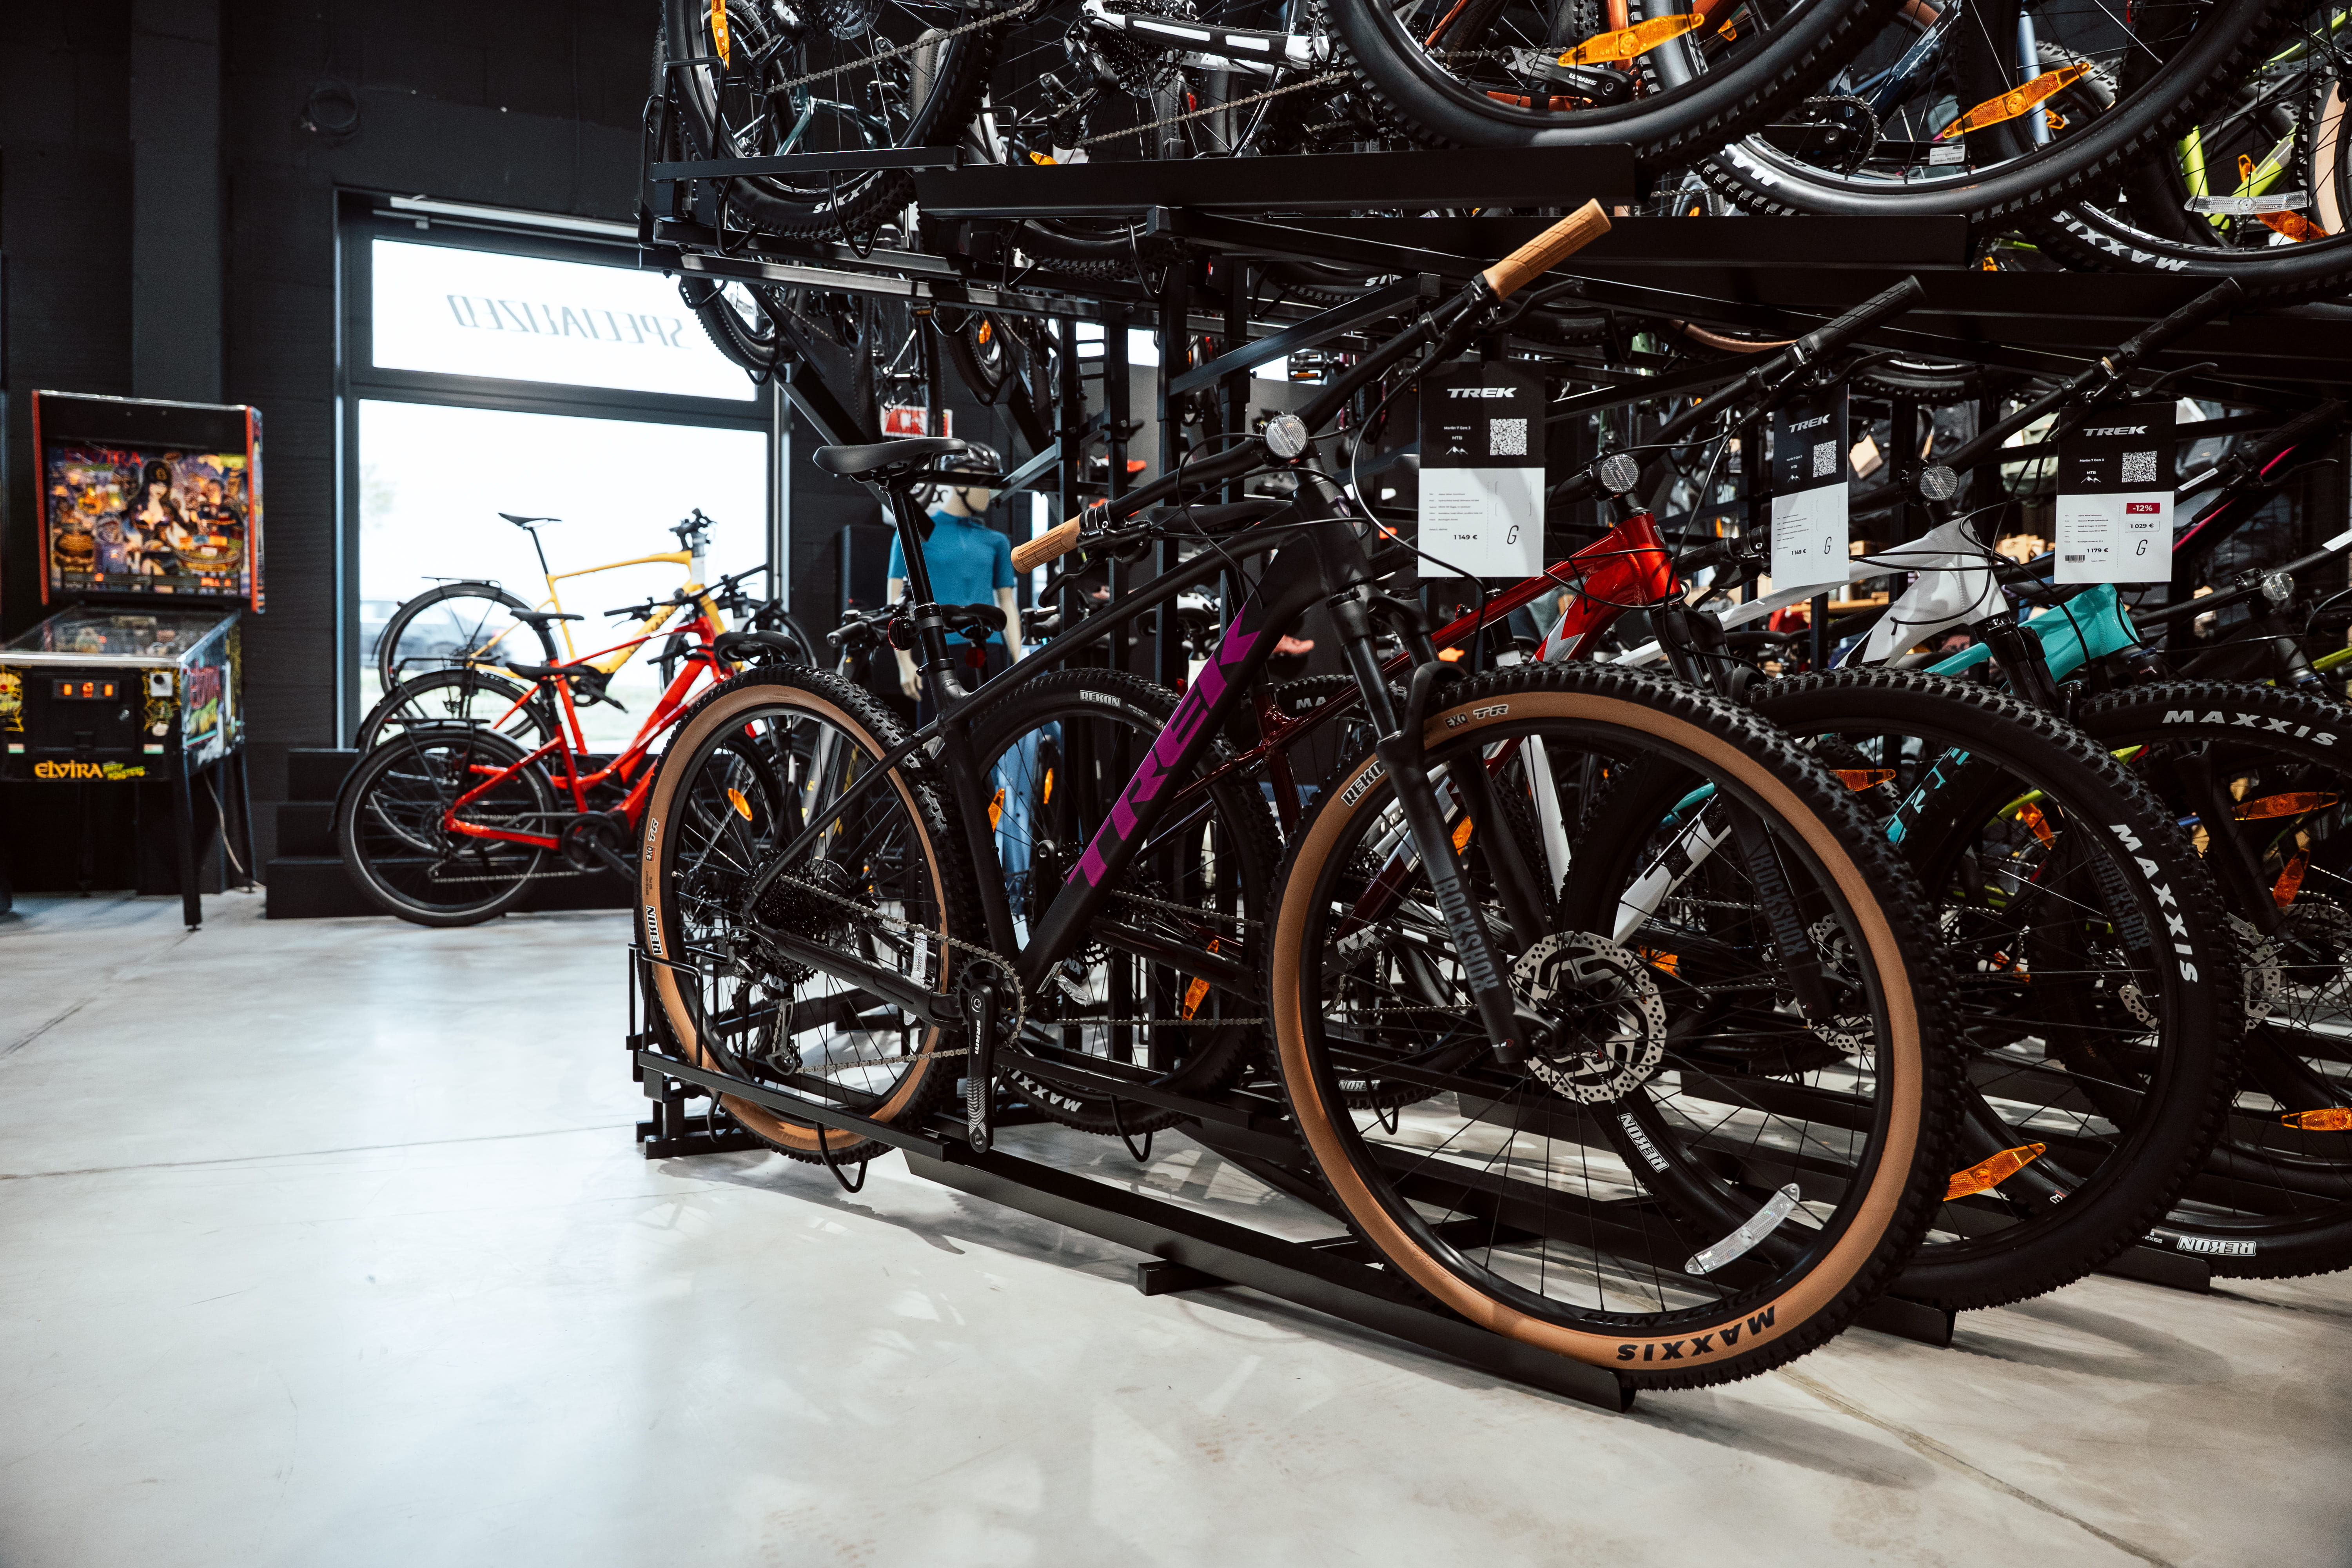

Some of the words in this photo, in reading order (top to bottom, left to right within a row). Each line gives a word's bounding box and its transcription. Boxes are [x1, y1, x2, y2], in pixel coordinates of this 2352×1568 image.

[1568, 73, 1597, 85] SRAM
[813, 171, 884, 213] AXXIS
[2051, 211, 2189, 271] MAXXIS
[1447, 387, 1517, 398] TREK
[1789, 414, 1830, 433] TREK
[2083, 426, 2148, 436] TREK
[1507, 525, 1519, 544] G
[1824, 536, 1832, 555] G
[2136, 539, 2148, 556] G
[1080, 690, 1121, 708] REKON
[1445, 713, 1468, 729] EXO
[1473, 704, 1509, 719] TR
[2162, 710, 2337, 746] MAXXIS
[1068, 604, 1261, 887] TREK
[34, 760, 103, 779] ELVIRA
[1341, 760, 1385, 807] REKO
[648, 817, 659, 842] TR
[646, 846, 654, 862] EXO
[1749, 855, 1809, 957] ROCKSHOX
[2109, 824, 2198, 983] MAXXIS
[645, 905, 663, 955] REKON
[1435, 877, 1499, 993] ROCKSHOX
[1007, 1067, 1082, 1112] MAXXI
[1617, 1113, 1670, 1173] REKON
[2177, 1236, 2256, 1256] REKON
[1616, 1305, 1775, 1361] MAXXIS
